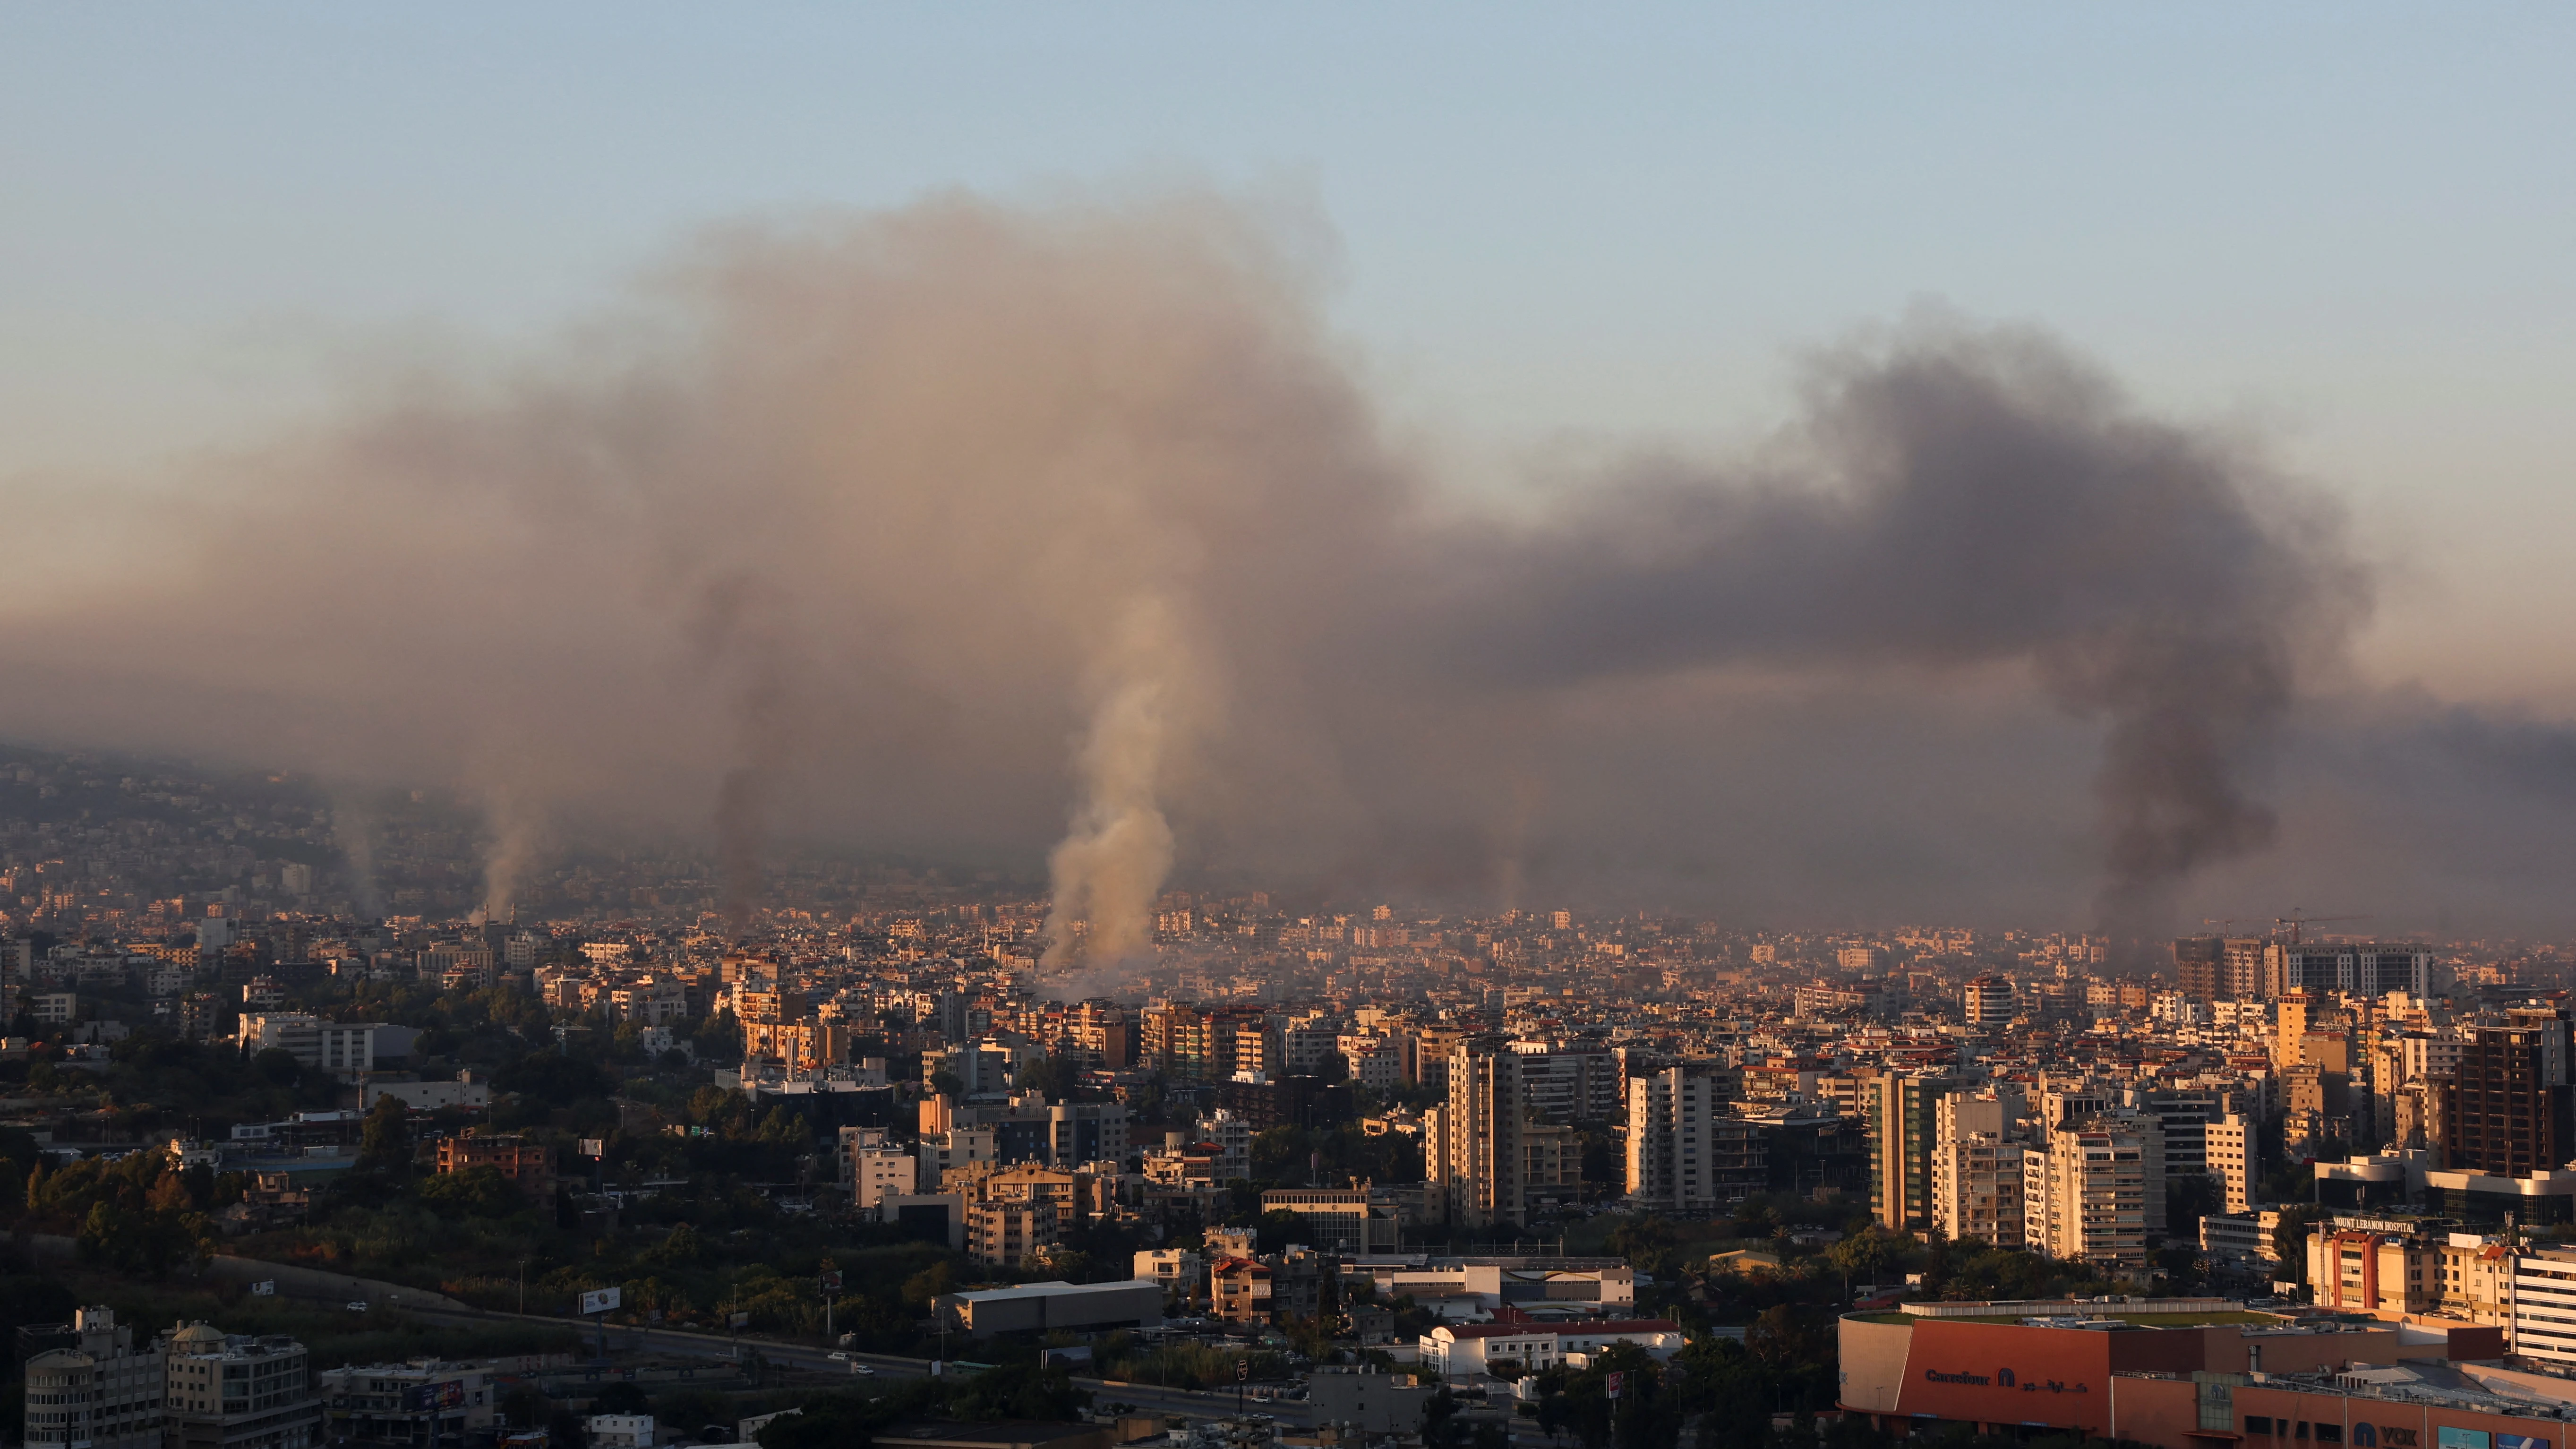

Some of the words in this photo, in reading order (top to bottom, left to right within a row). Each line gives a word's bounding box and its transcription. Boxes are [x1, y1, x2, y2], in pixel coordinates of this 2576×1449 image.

[2333, 1217, 2355, 1228] MOUNT
[2356, 1219, 2384, 1231] LEBANON
[2385, 1221, 2415, 1233] HOSPITAL
[67, 1349, 83, 1361] KEY
[1925, 1369, 1990, 1386] Carrefour
[2020, 1379, 2088, 1393] كارفور
[2379, 1426, 2417, 1446] VOX
